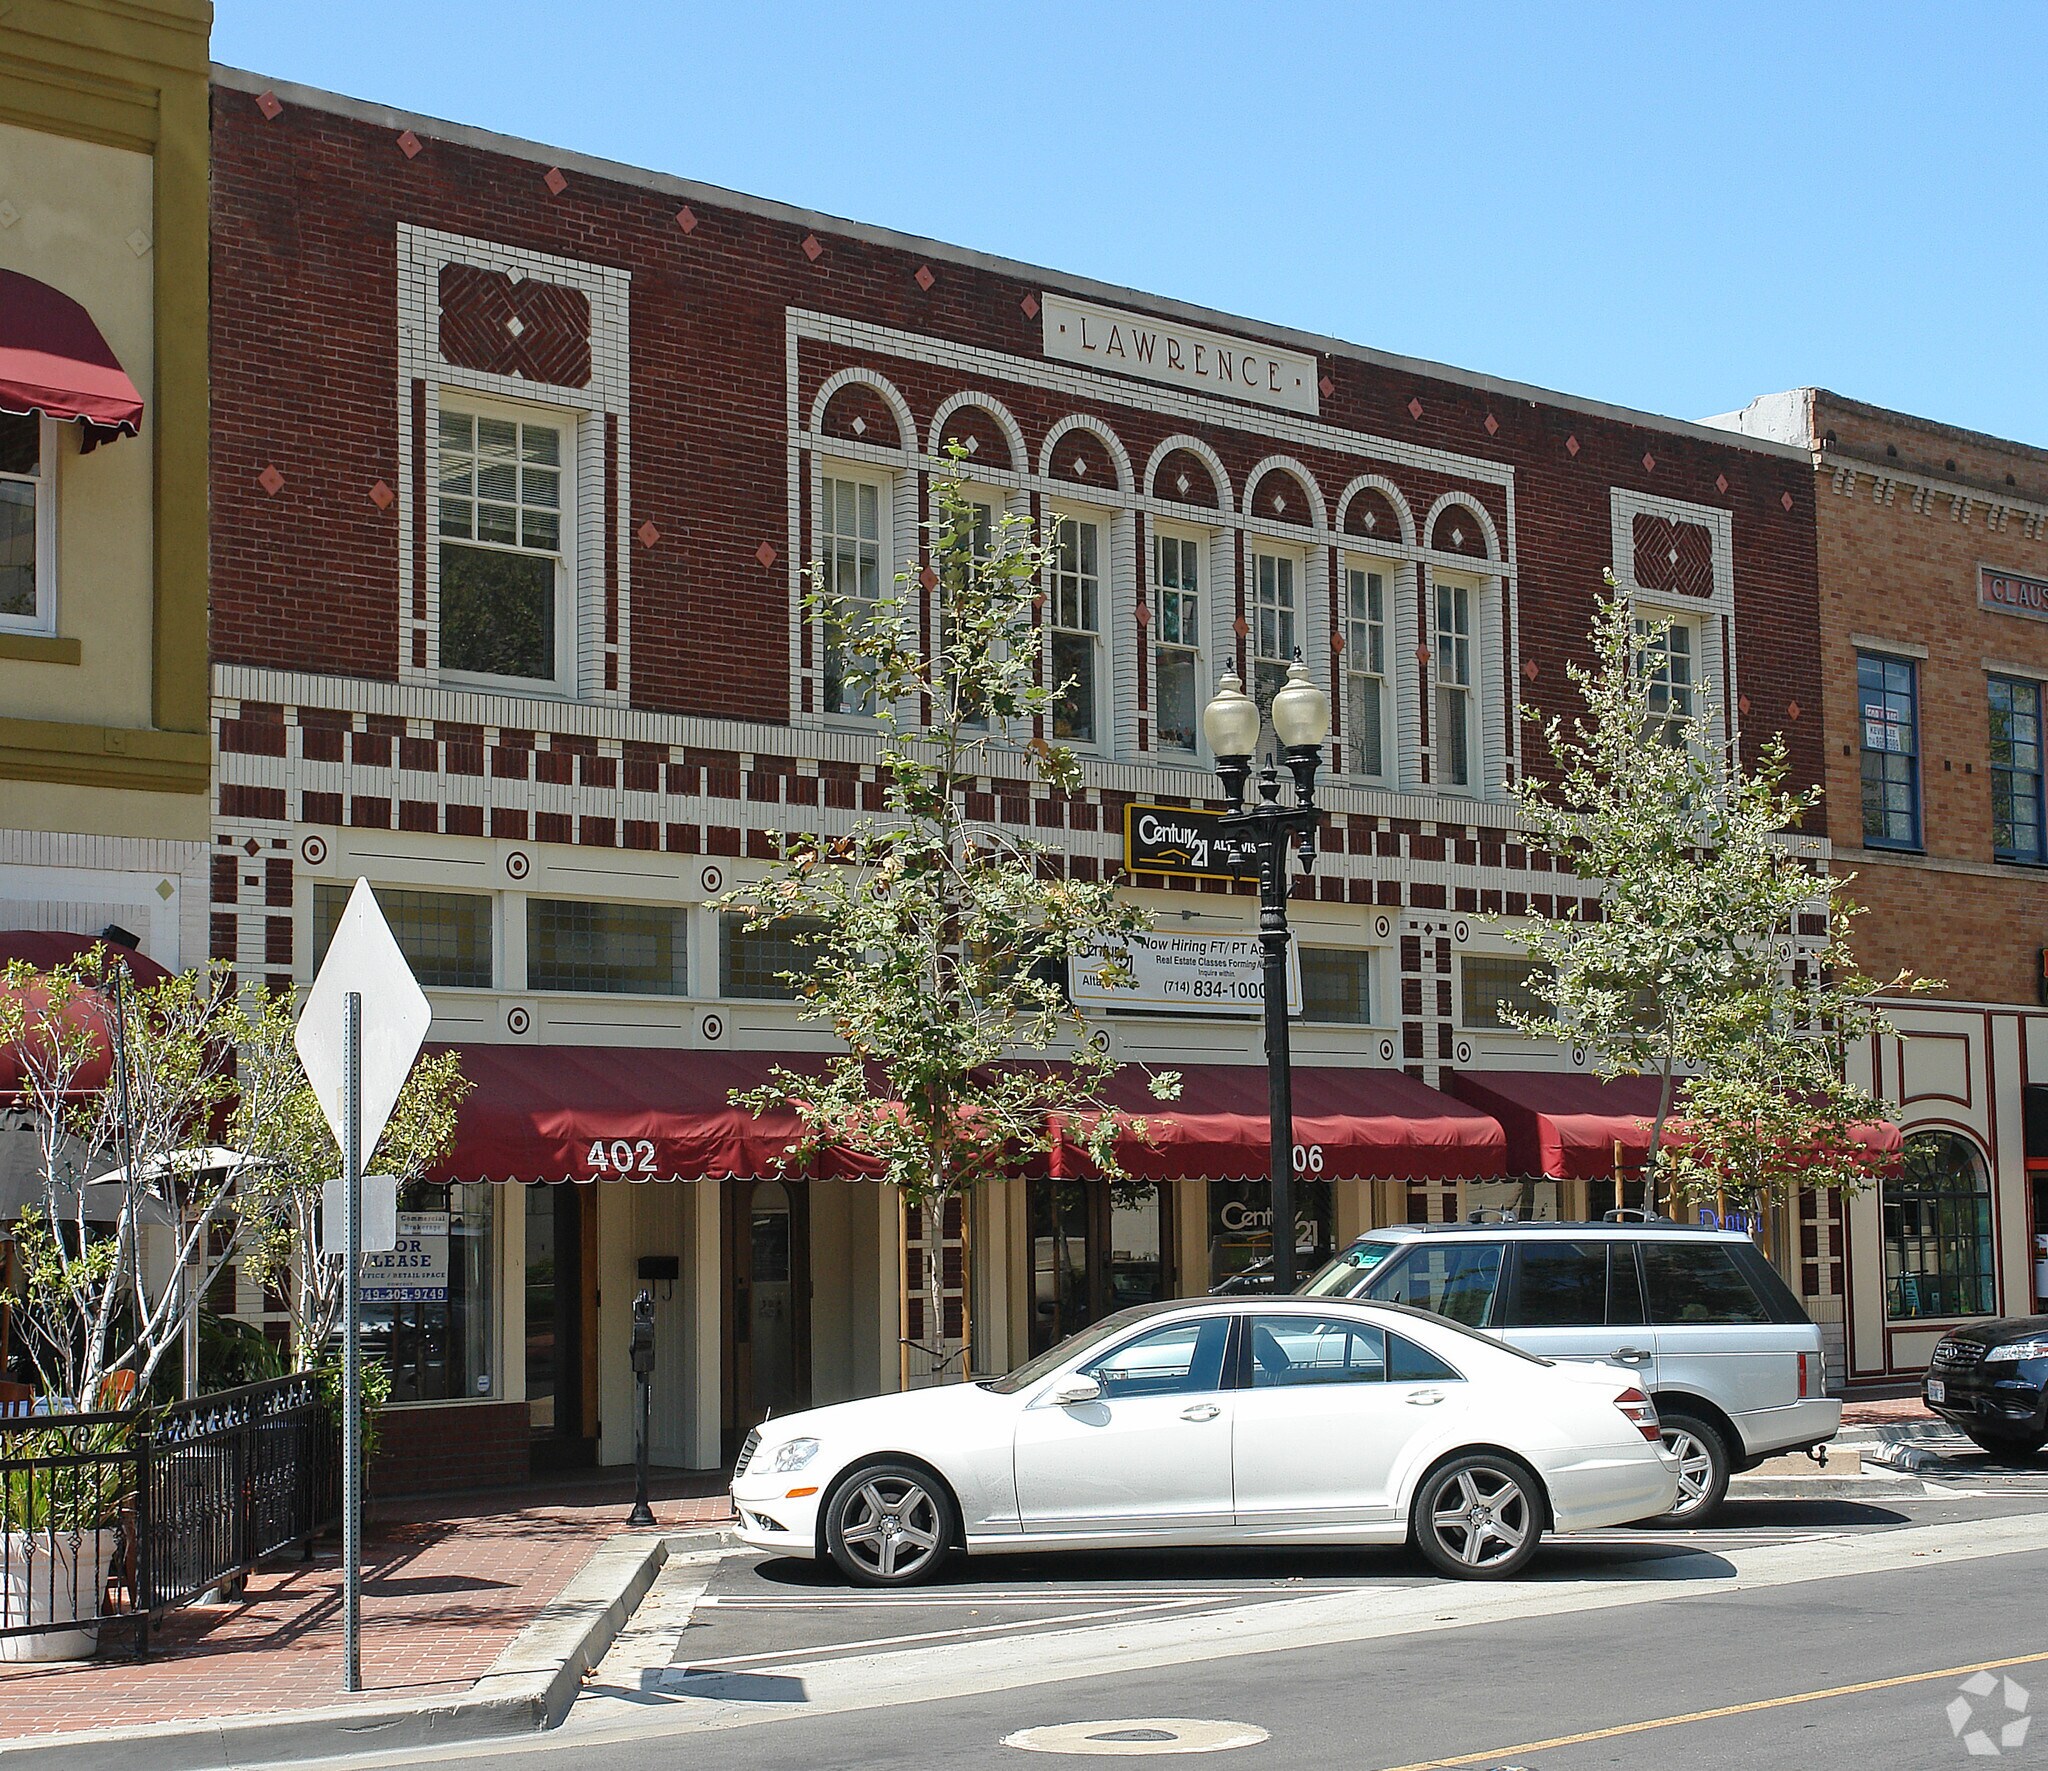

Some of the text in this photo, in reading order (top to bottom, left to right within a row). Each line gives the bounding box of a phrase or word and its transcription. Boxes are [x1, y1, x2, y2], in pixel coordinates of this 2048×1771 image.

[1080, 317, 1283, 393] LAWRENCE
[1138, 814, 1209, 867] Century 21
[1213, 839, 1231, 852] ALT
[1141, 937, 1168, 951] Now
[1171, 938, 1207, 955] Hiring
[1210, 941, 1230, 954] FT/
[1232, 942, 1247, 955] PT
[1156, 955, 1172, 965] Real
[1174, 956, 1196, 966] Estate
[1198, 957, 1227, 968] Classes
[1228, 959, 1256, 970] Forming
[1198, 969, 1218, 977] Inquire
[1164, 980, 1266, 999] (714) 834-1000
[587, 1140, 658, 1173] 402
[1292, 1144, 1324, 1173] 06
[1700, 1208, 1764, 1233] Dentit
[1295, 1220, 1319, 1247] 21
[385, 1240, 422, 1253] OR
[372, 1255, 432, 1268] LEASE
